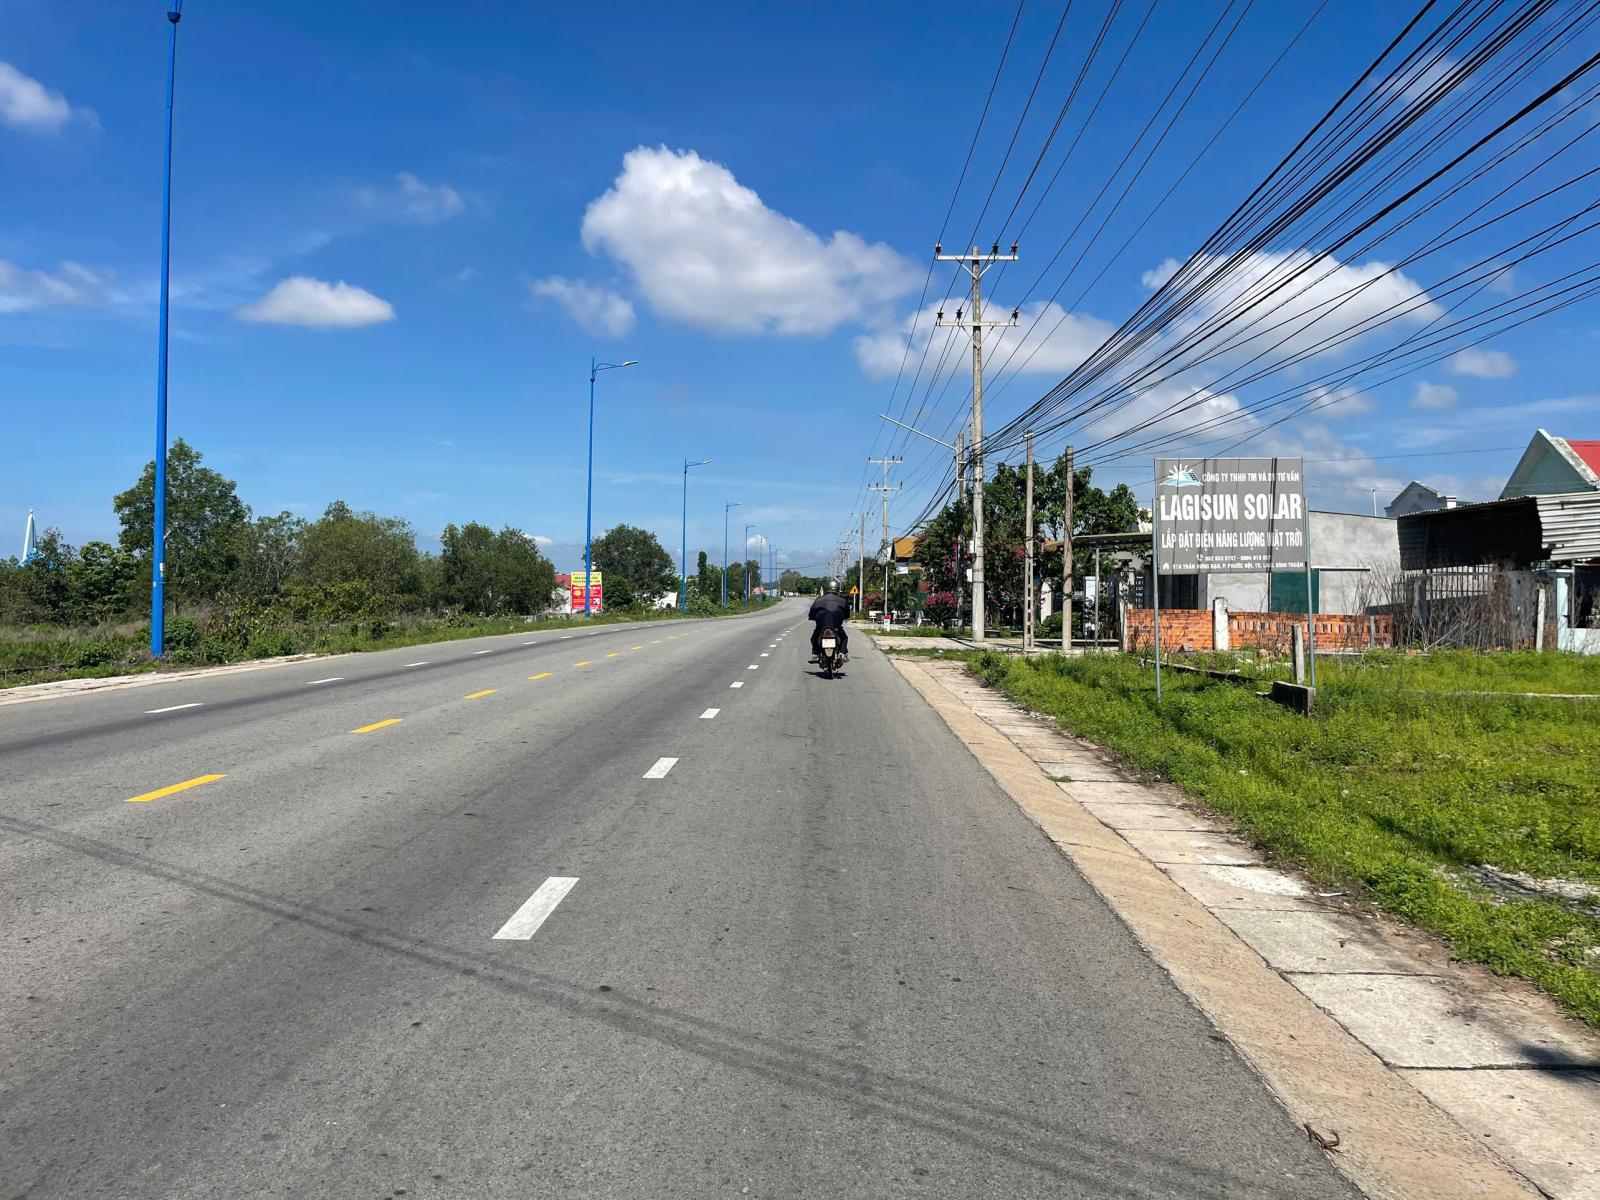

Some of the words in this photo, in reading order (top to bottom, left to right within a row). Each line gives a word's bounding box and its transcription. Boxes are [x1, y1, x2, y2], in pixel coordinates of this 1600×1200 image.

[1221, 472, 1228, 482] TY
[1230, 472, 1246, 482] TNHH
[1247, 472, 1257, 482] TM
[1258, 471, 1267, 481] VÀ
[1160, 494, 1238, 521] LAGISUN
[1244, 493, 1302, 520] SOLAR
[1161, 528, 1177, 548] LẮP
[1179, 530, 1193, 551] ĐẶT
[1195, 530, 1215, 551] ĐIỆN
[1216, 529, 1238, 548] NĂNG
[1239, 530, 1265, 550] LƯỢNG
[1285, 528, 1303, 547] TRỜI
